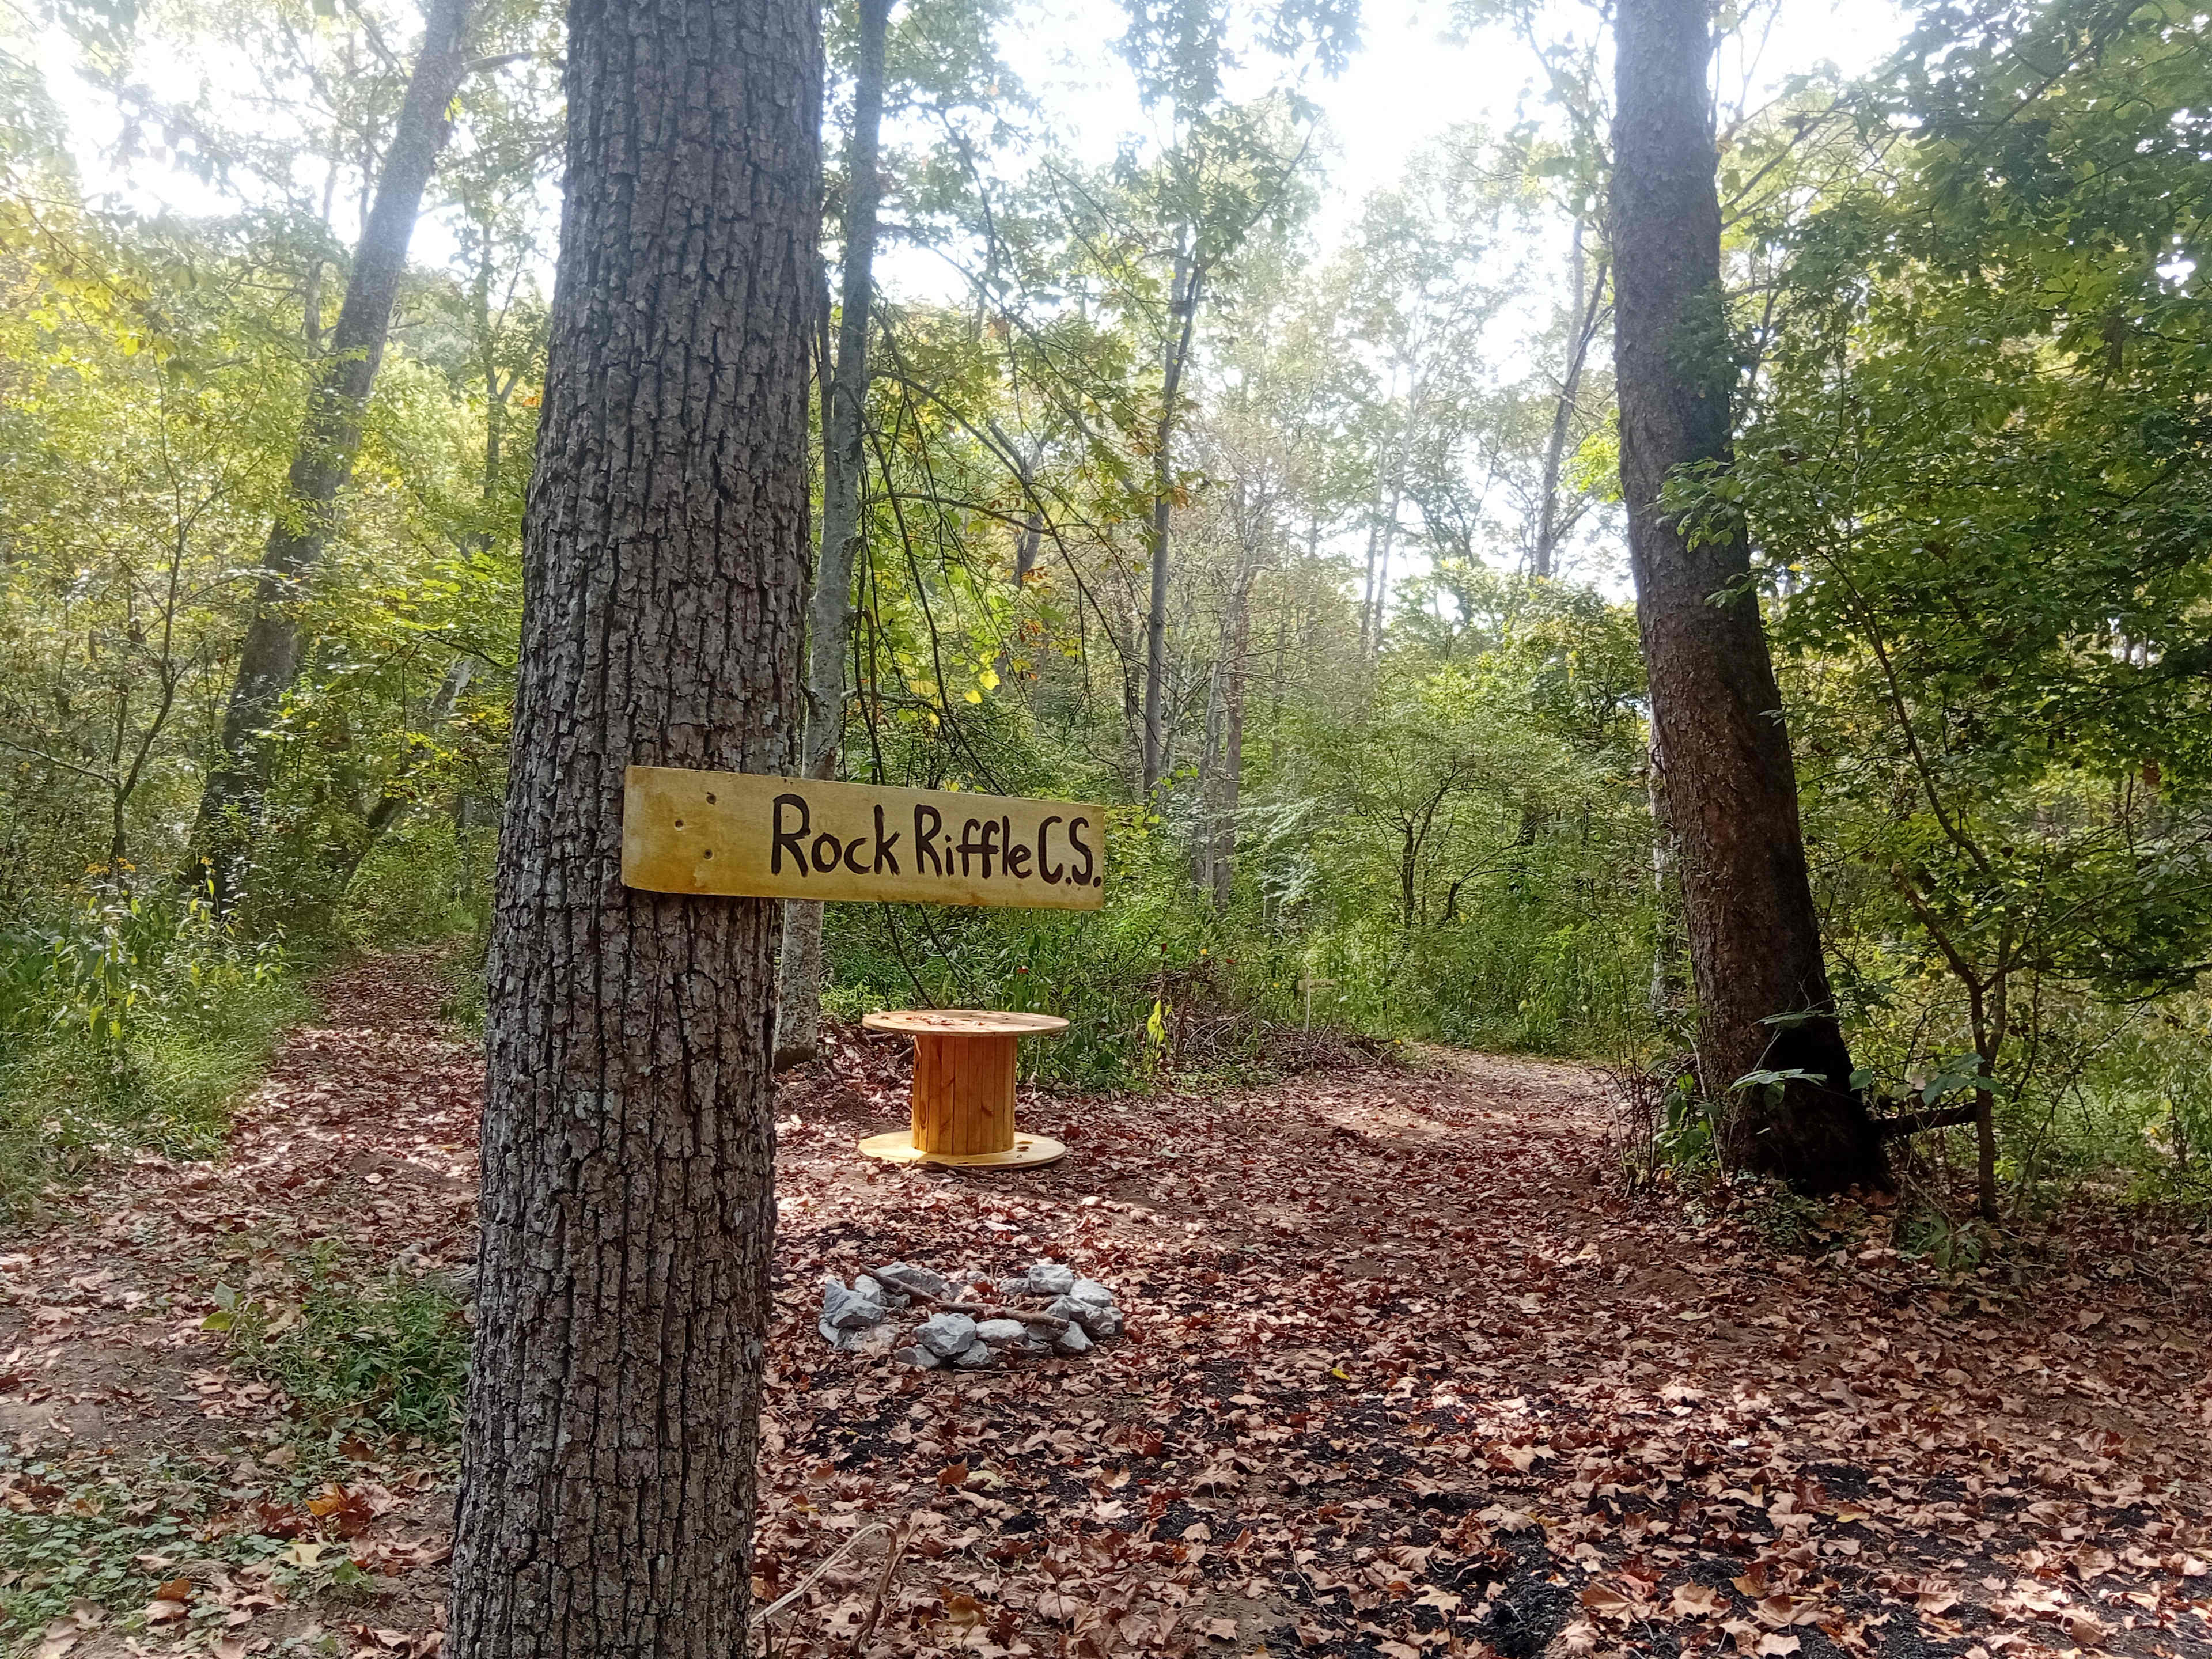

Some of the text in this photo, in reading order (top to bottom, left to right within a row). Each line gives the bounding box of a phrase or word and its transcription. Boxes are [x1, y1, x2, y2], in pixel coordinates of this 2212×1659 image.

[771, 794, 1103, 887] Rock Riffle C.S.
